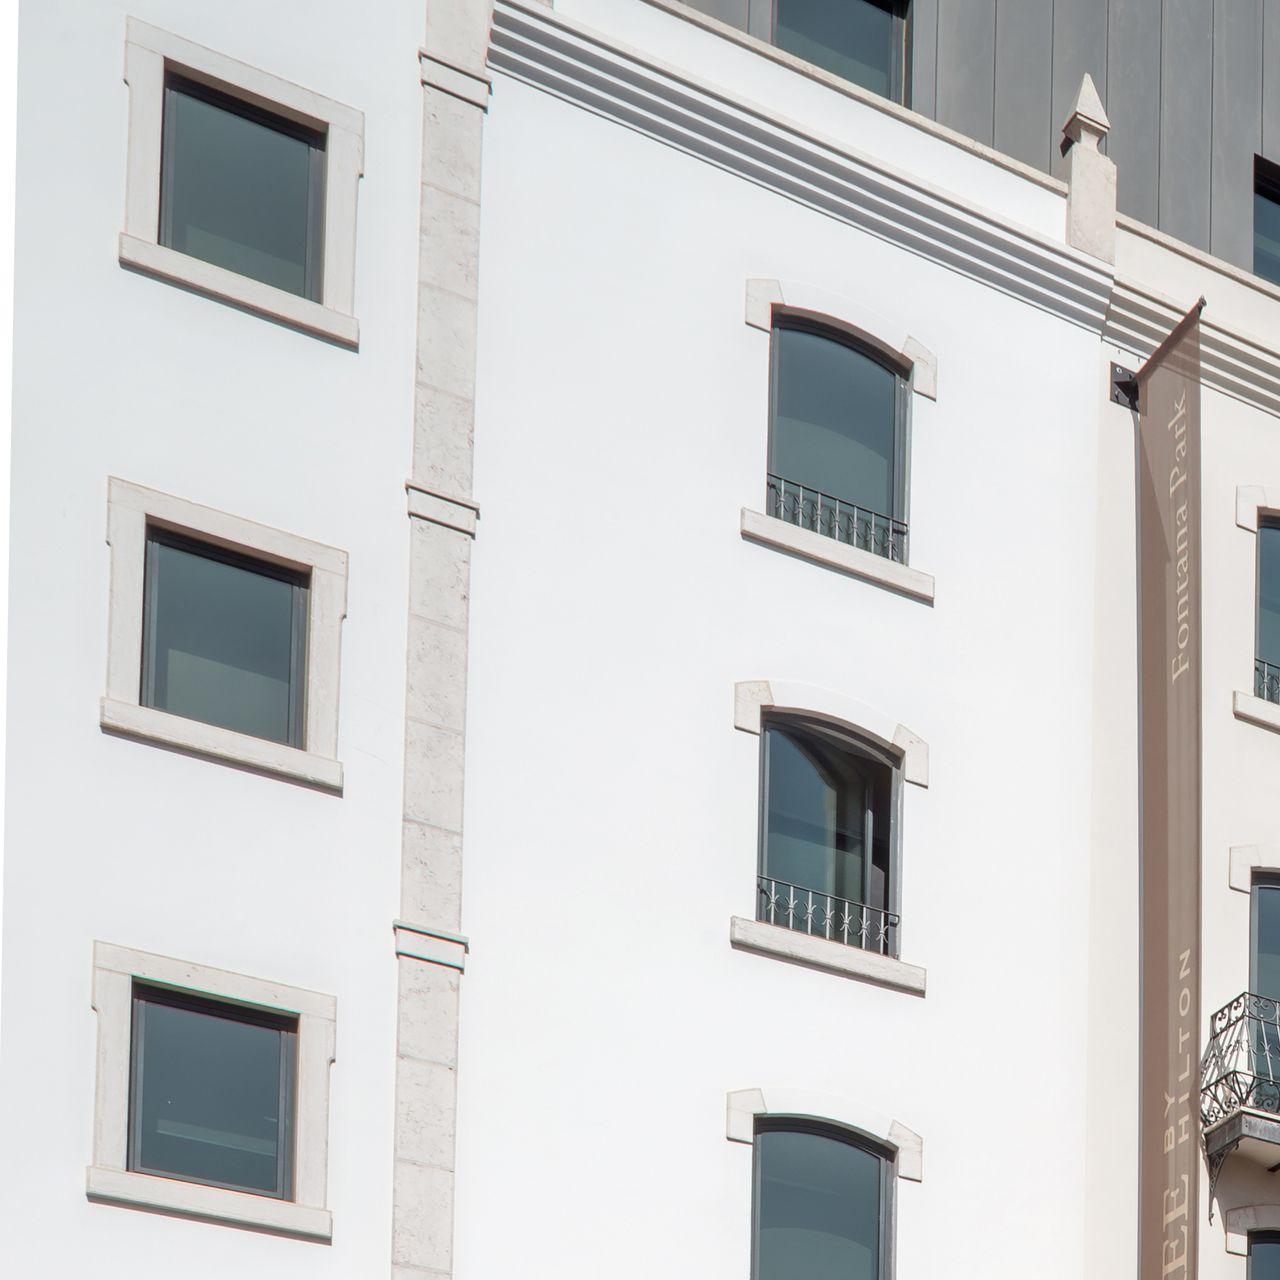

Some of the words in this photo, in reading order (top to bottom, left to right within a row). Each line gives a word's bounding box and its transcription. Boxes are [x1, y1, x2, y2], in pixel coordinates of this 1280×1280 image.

[1168, 388, 1187, 497] Park
[1172, 501, 1190, 684] Fontana
[1177, 948, 1191, 1144] HILTON
[1163, 1091, 1176, 1154] BY
